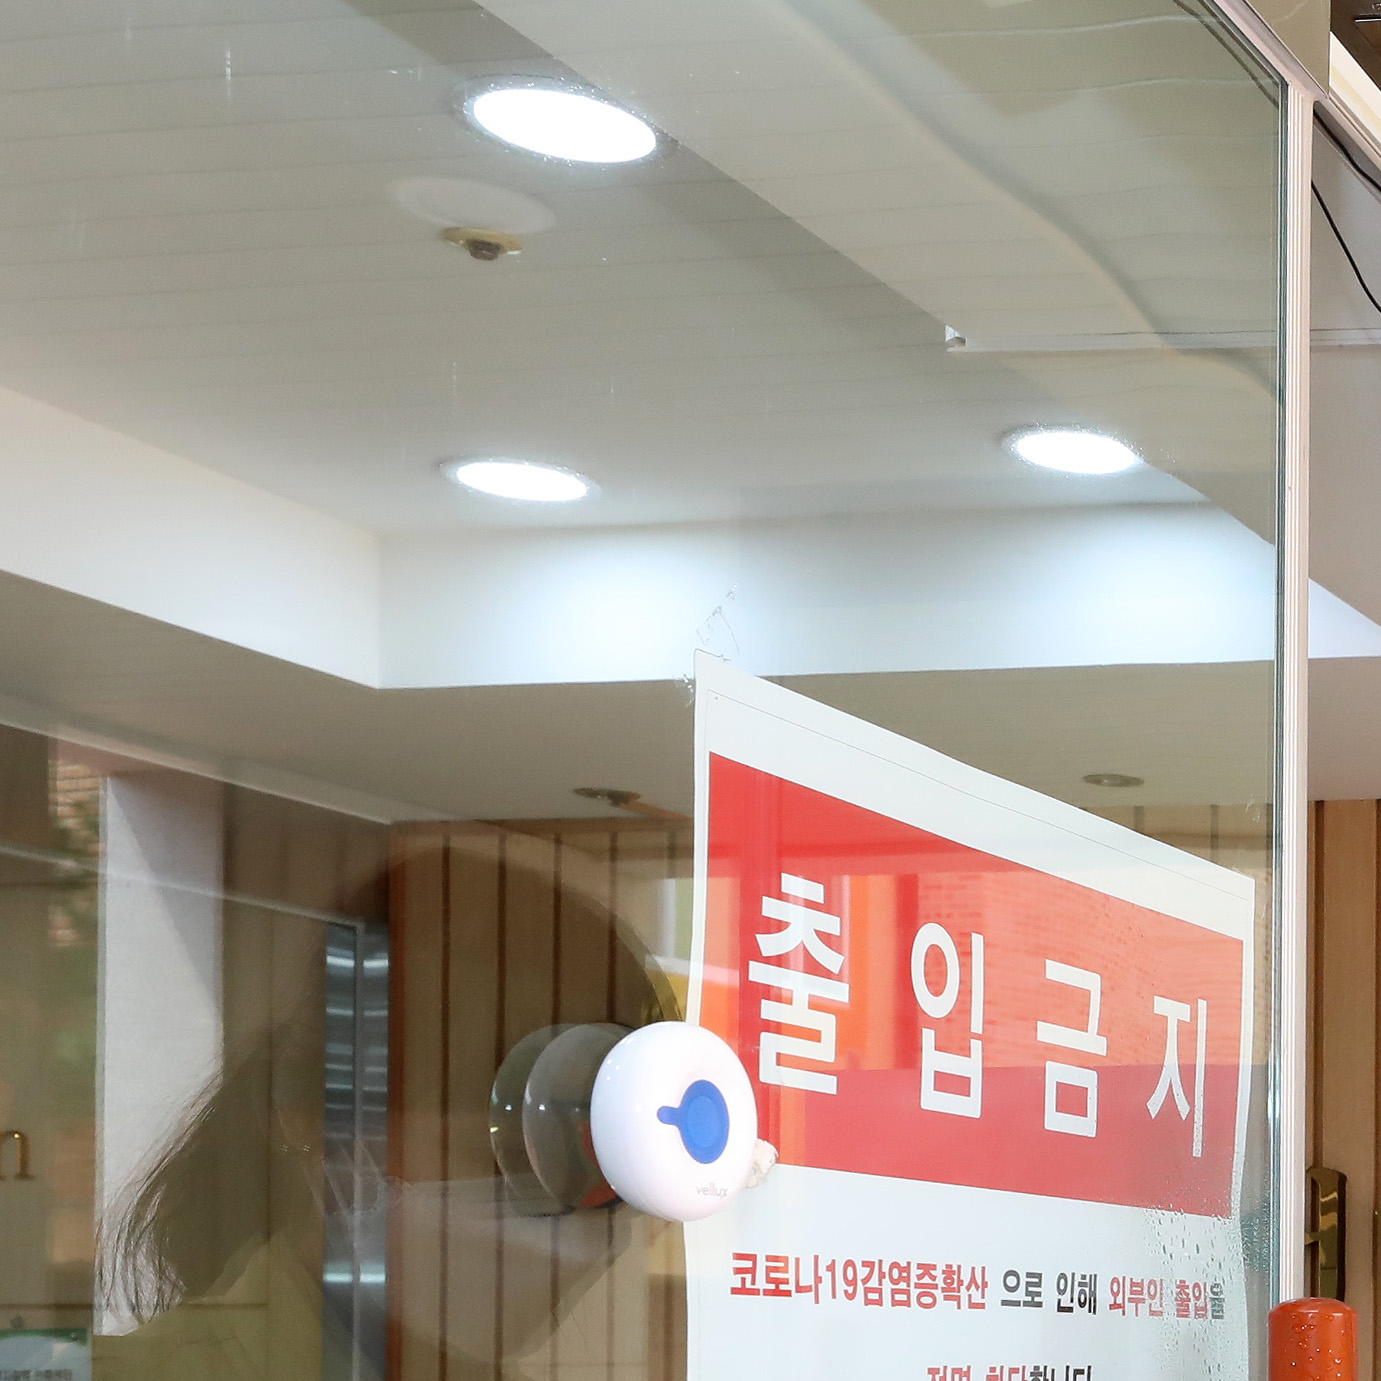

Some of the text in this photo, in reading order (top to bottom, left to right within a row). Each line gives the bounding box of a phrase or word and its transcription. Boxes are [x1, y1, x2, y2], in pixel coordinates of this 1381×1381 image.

[748, 872, 1207, 1157] 출입금지
[730, 1252, 988, 1310] 코로나19감염증확산
[1000, 1269, 1044, 1308] 으로
[1056, 1271, 1098, 1315] 인해
[1108, 1275, 1164, 1317] 외부인
